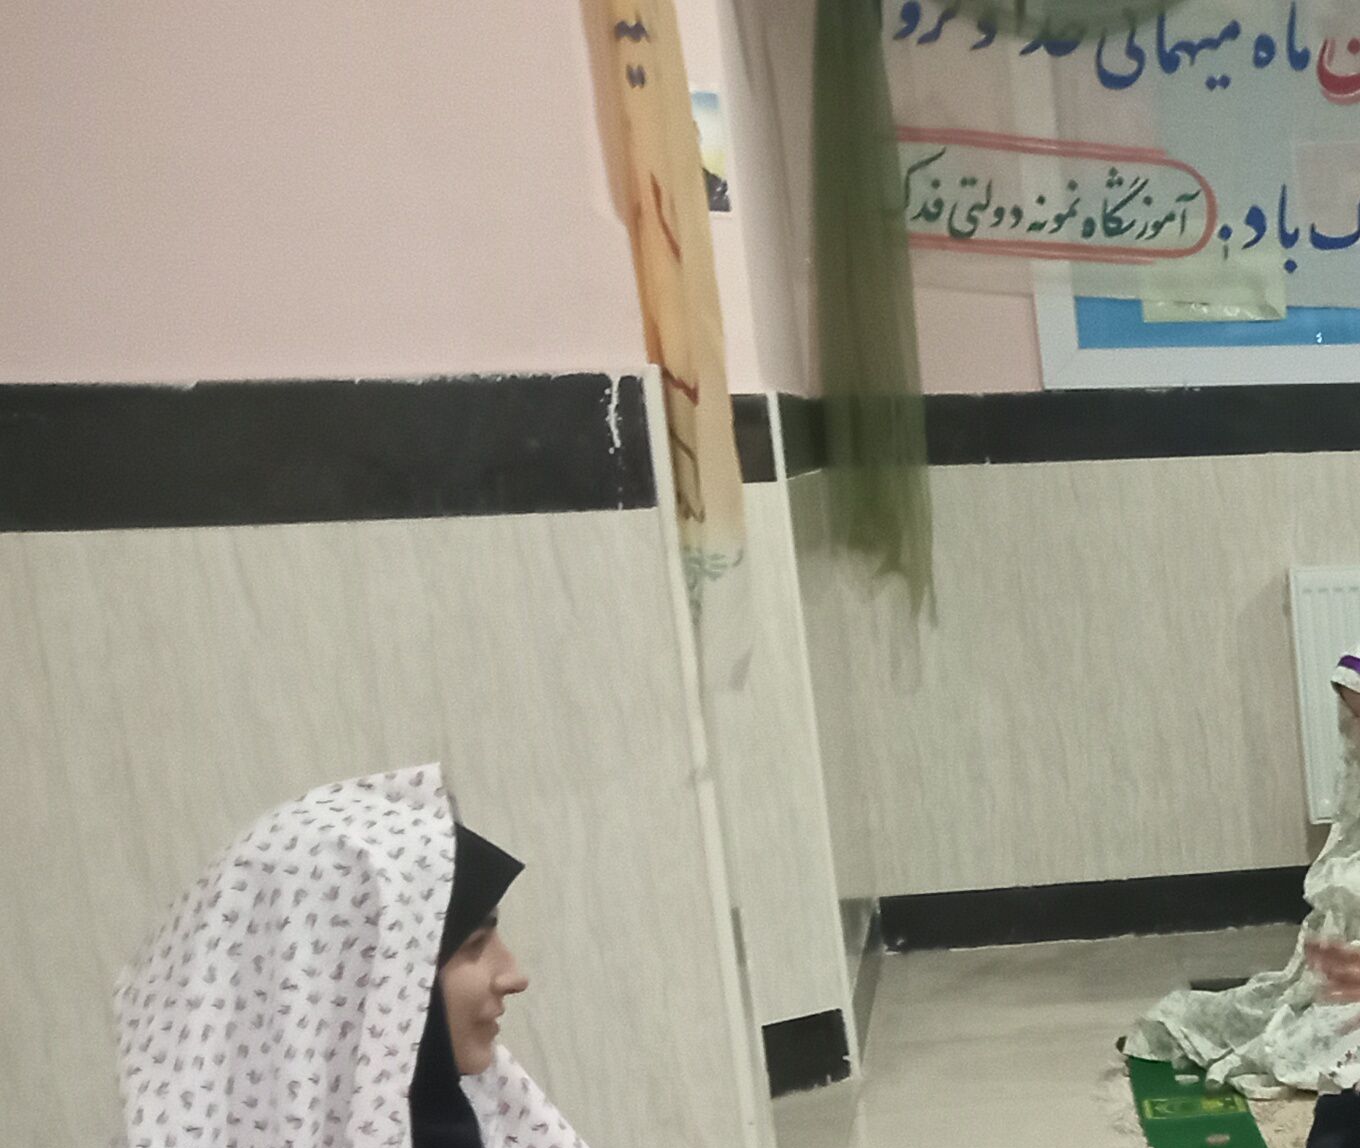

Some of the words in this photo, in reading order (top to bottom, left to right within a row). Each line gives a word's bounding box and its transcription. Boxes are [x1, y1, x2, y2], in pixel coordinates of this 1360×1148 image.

[1252, 0, 1311, 71] ماه
[948, 177, 1023, 239] دولتی
[1026, 178, 1080, 234] نمونه
[1081, 166, 1202, 241] آموزشگاه
